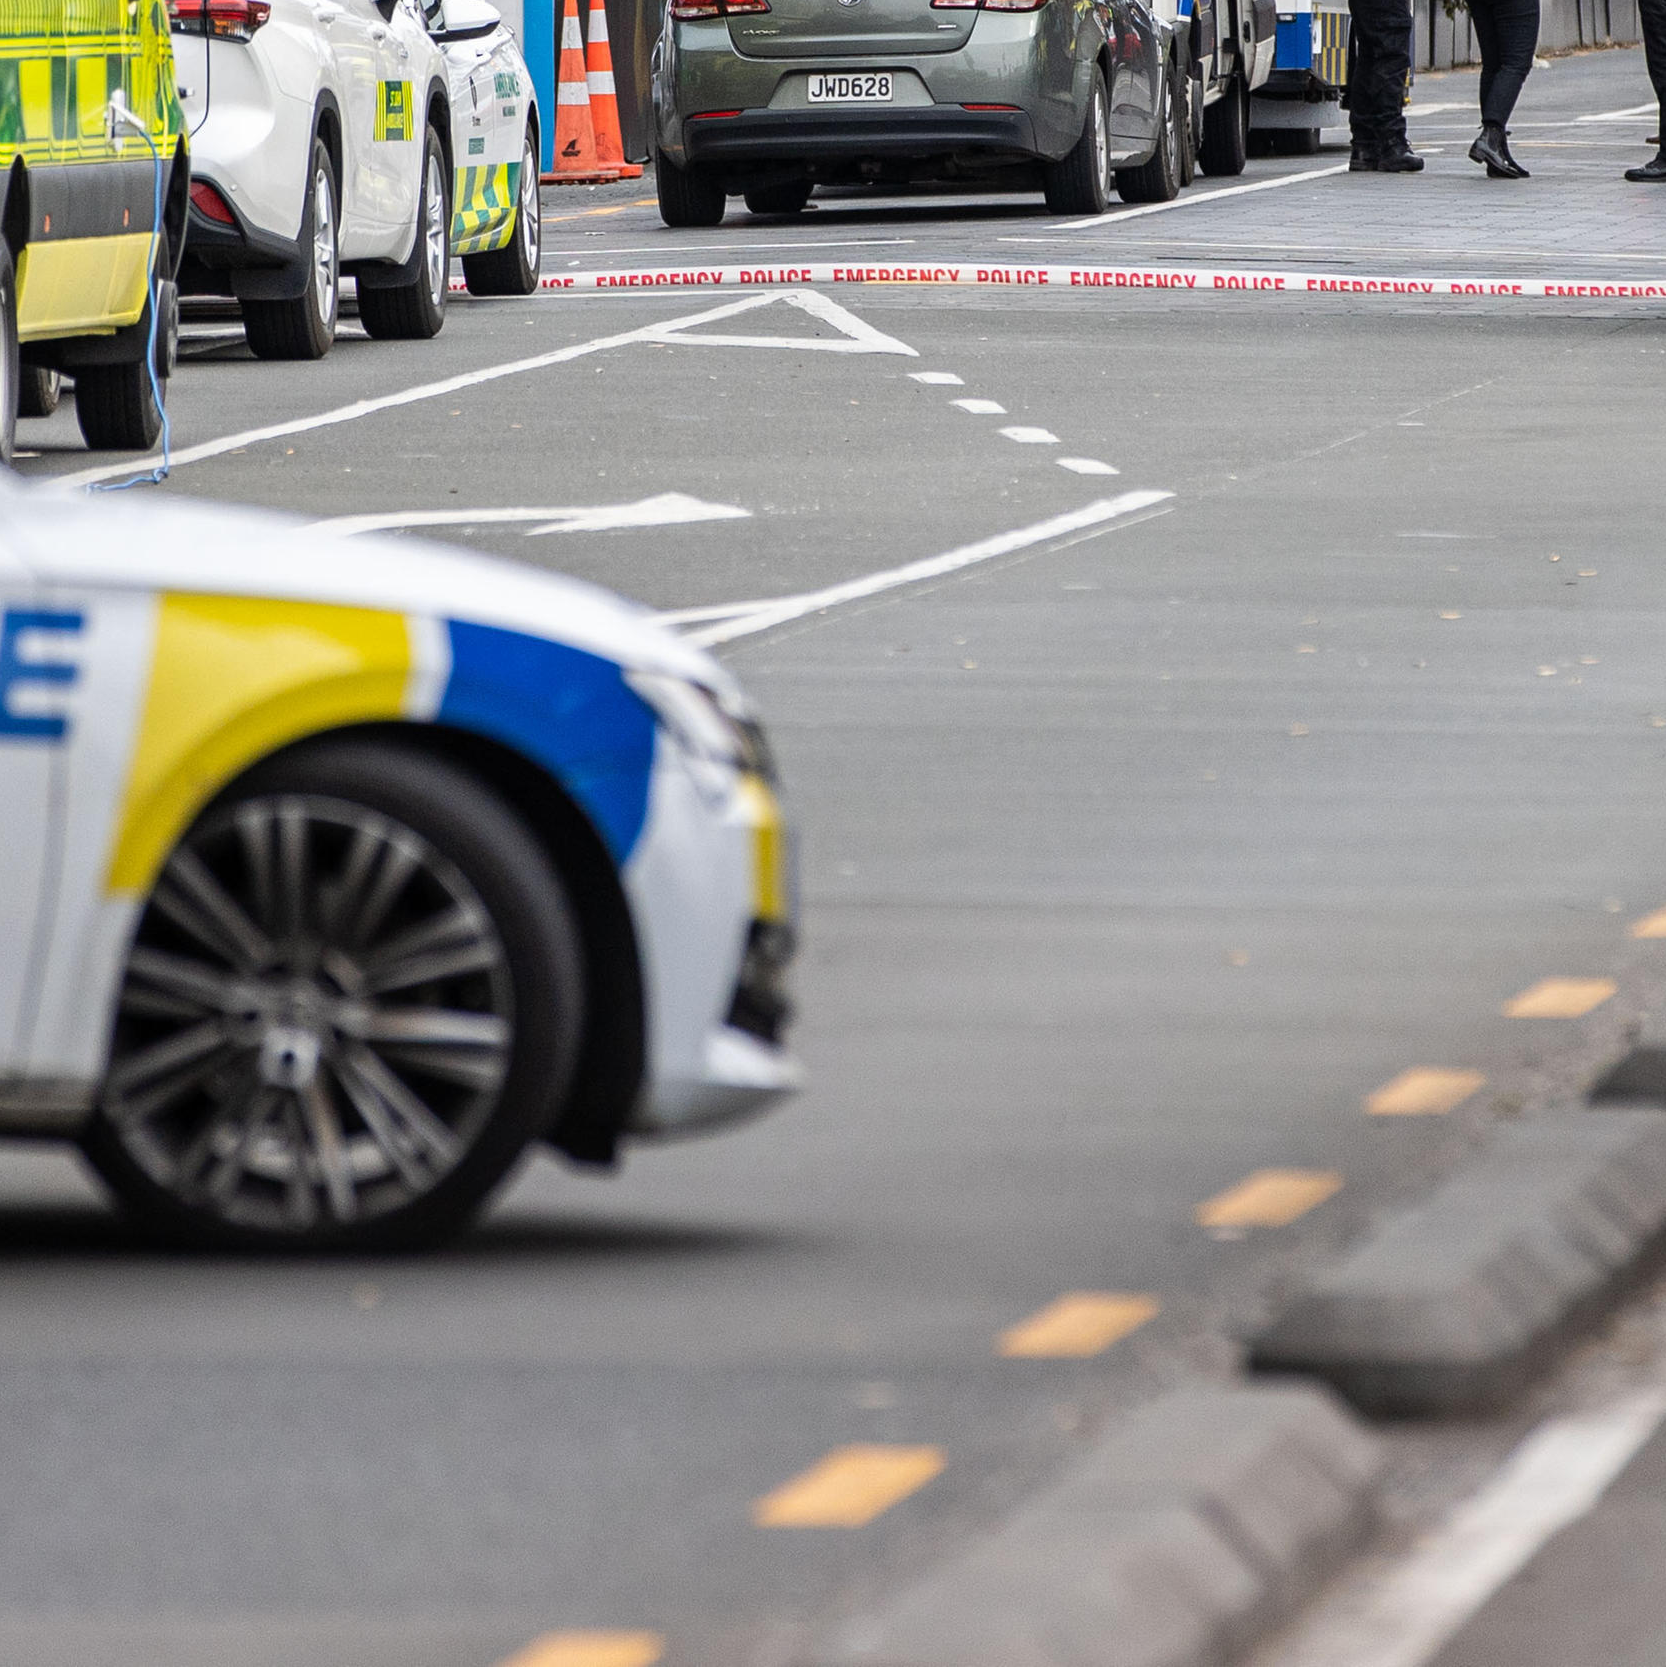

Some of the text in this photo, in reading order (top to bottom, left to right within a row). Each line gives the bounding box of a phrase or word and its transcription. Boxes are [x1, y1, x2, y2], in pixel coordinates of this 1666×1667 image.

[811, 77, 890, 98] JWD628
[739, 269, 812, 284] POLICE
[833, 268, 960, 283] EMERGENCY
[977, 270, 1049, 284] POLICE
[1070, 271, 1197, 289] EMERGENCY
[1213, 275, 1286, 291] POLICE
[1307, 278, 1434, 293] EMERGENCY
